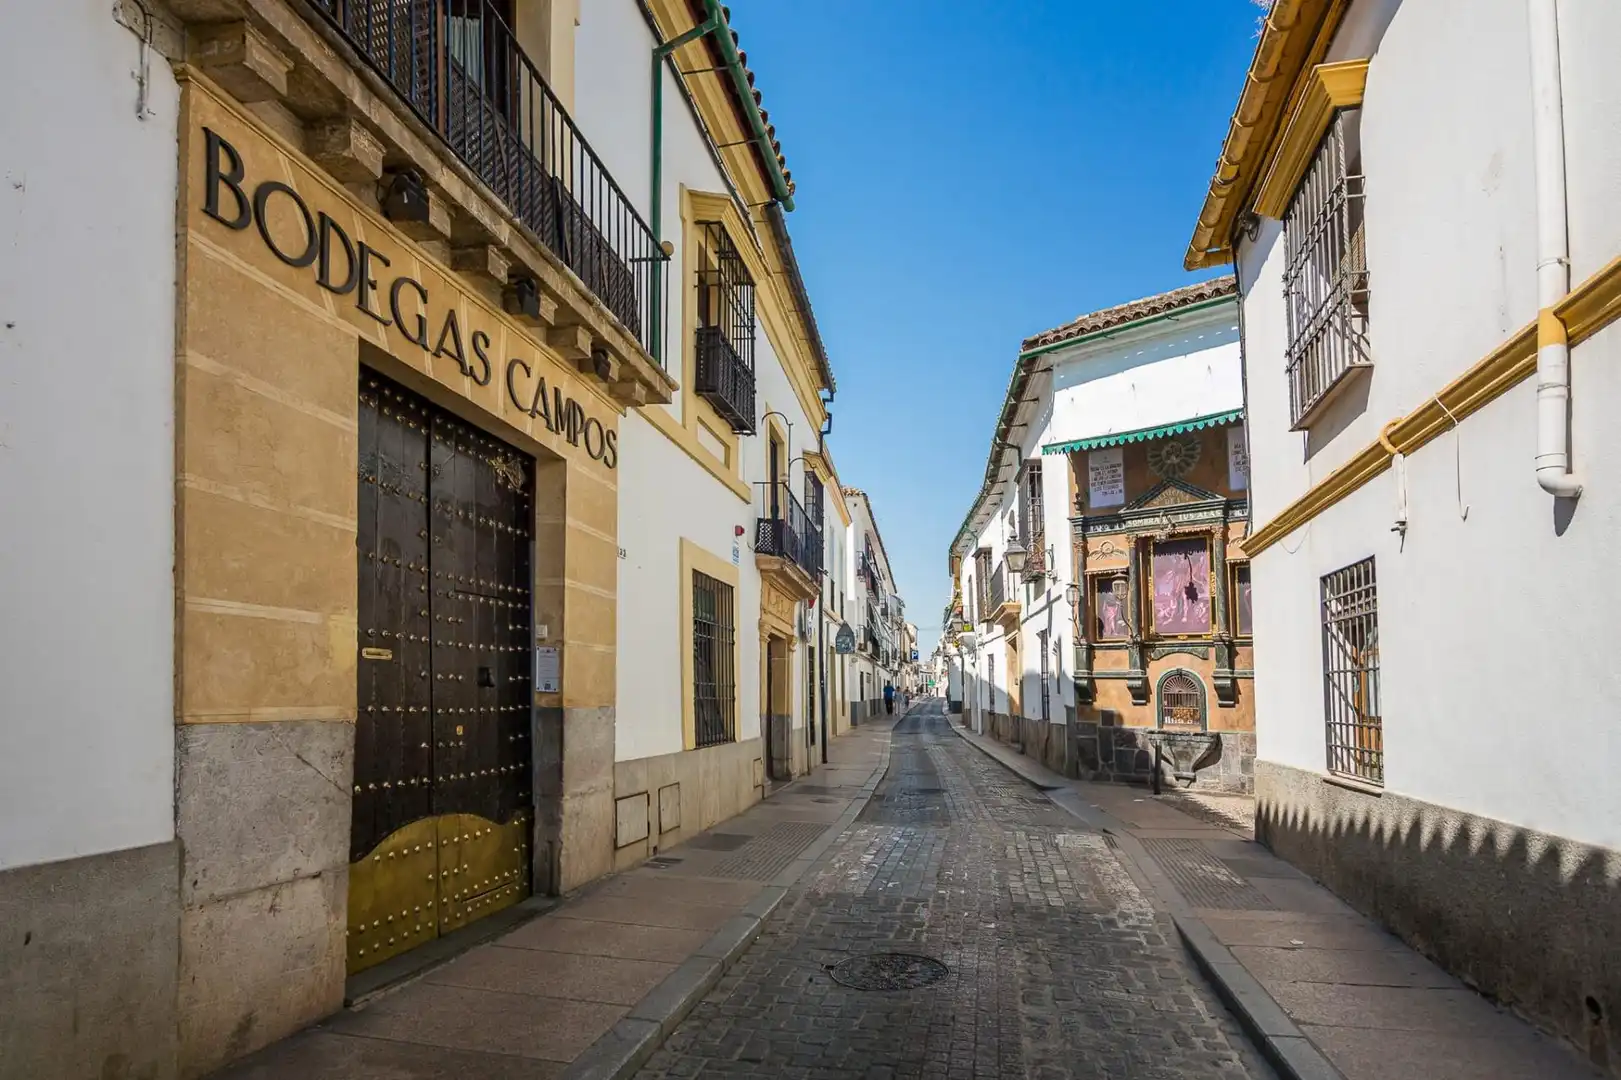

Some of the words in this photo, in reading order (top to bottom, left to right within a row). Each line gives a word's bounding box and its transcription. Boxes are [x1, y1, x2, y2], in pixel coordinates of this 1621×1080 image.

[202, 126, 490, 386] BODEGAS
[506, 358, 617, 469] CAMPOS
[1126, 517, 1160, 528] SOMBRA
